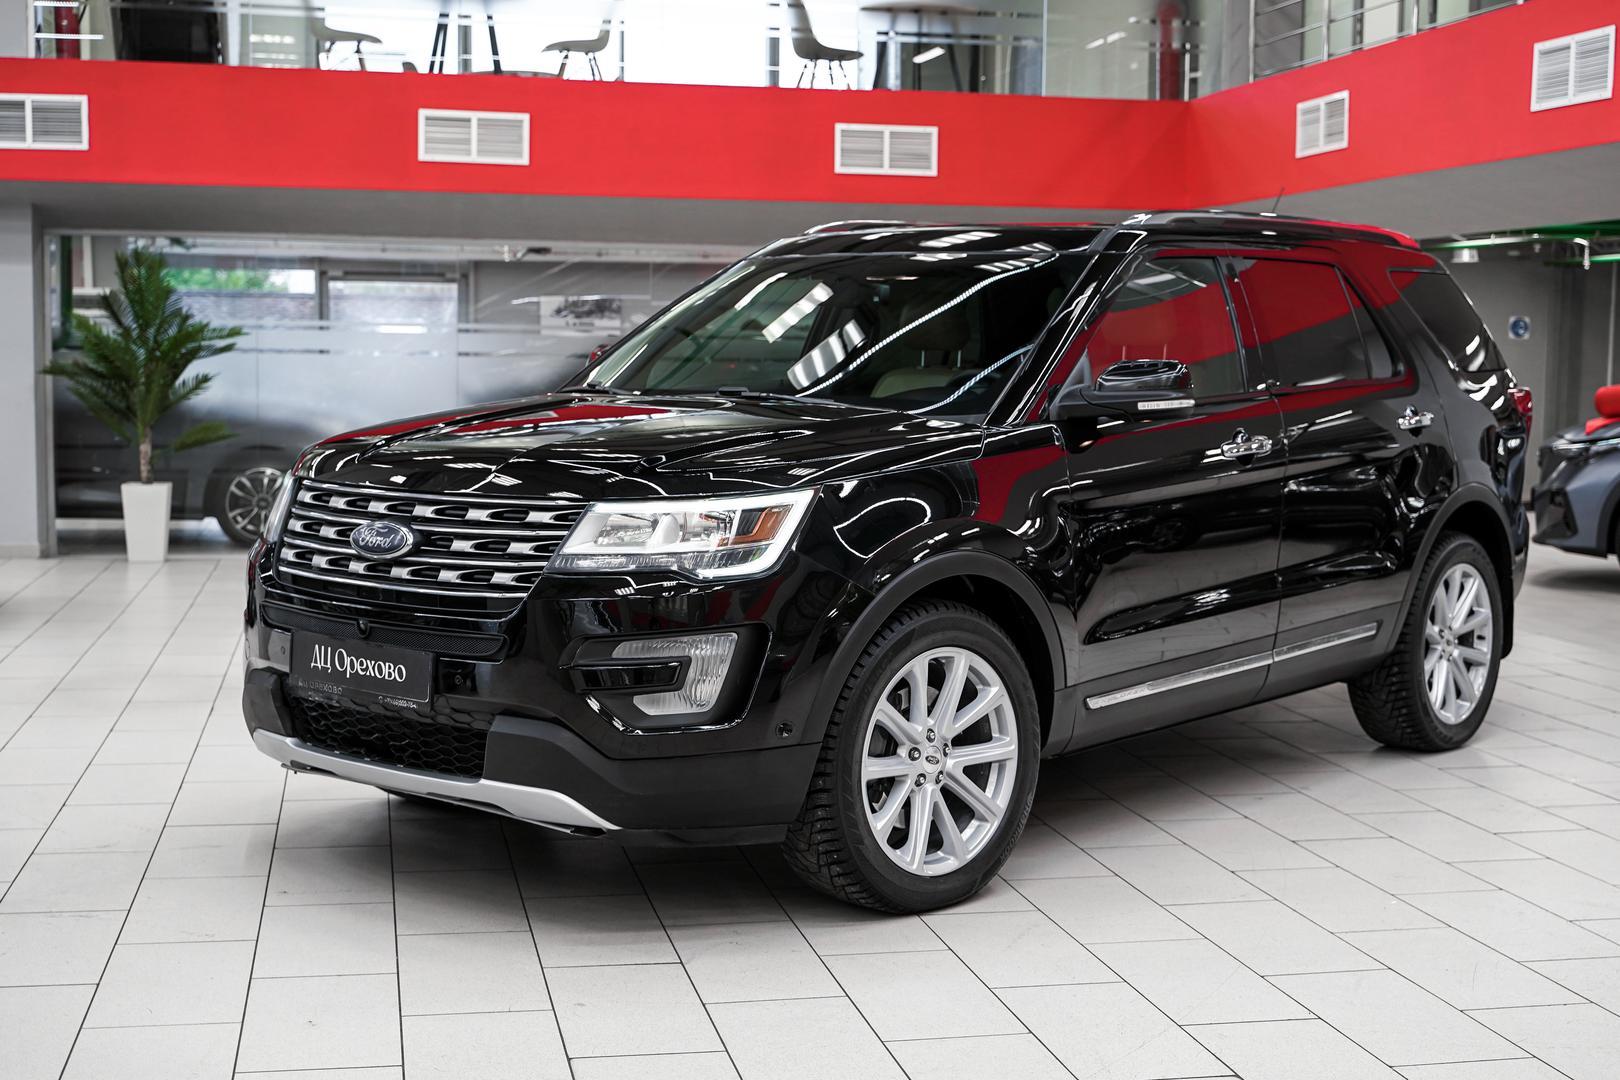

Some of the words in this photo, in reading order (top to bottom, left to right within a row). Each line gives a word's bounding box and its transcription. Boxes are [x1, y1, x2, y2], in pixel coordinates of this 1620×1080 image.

[359, 526, 395, 548] Ford
[310, 643, 332, 674] ДЦ
[334, 647, 407, 683] Орехово
